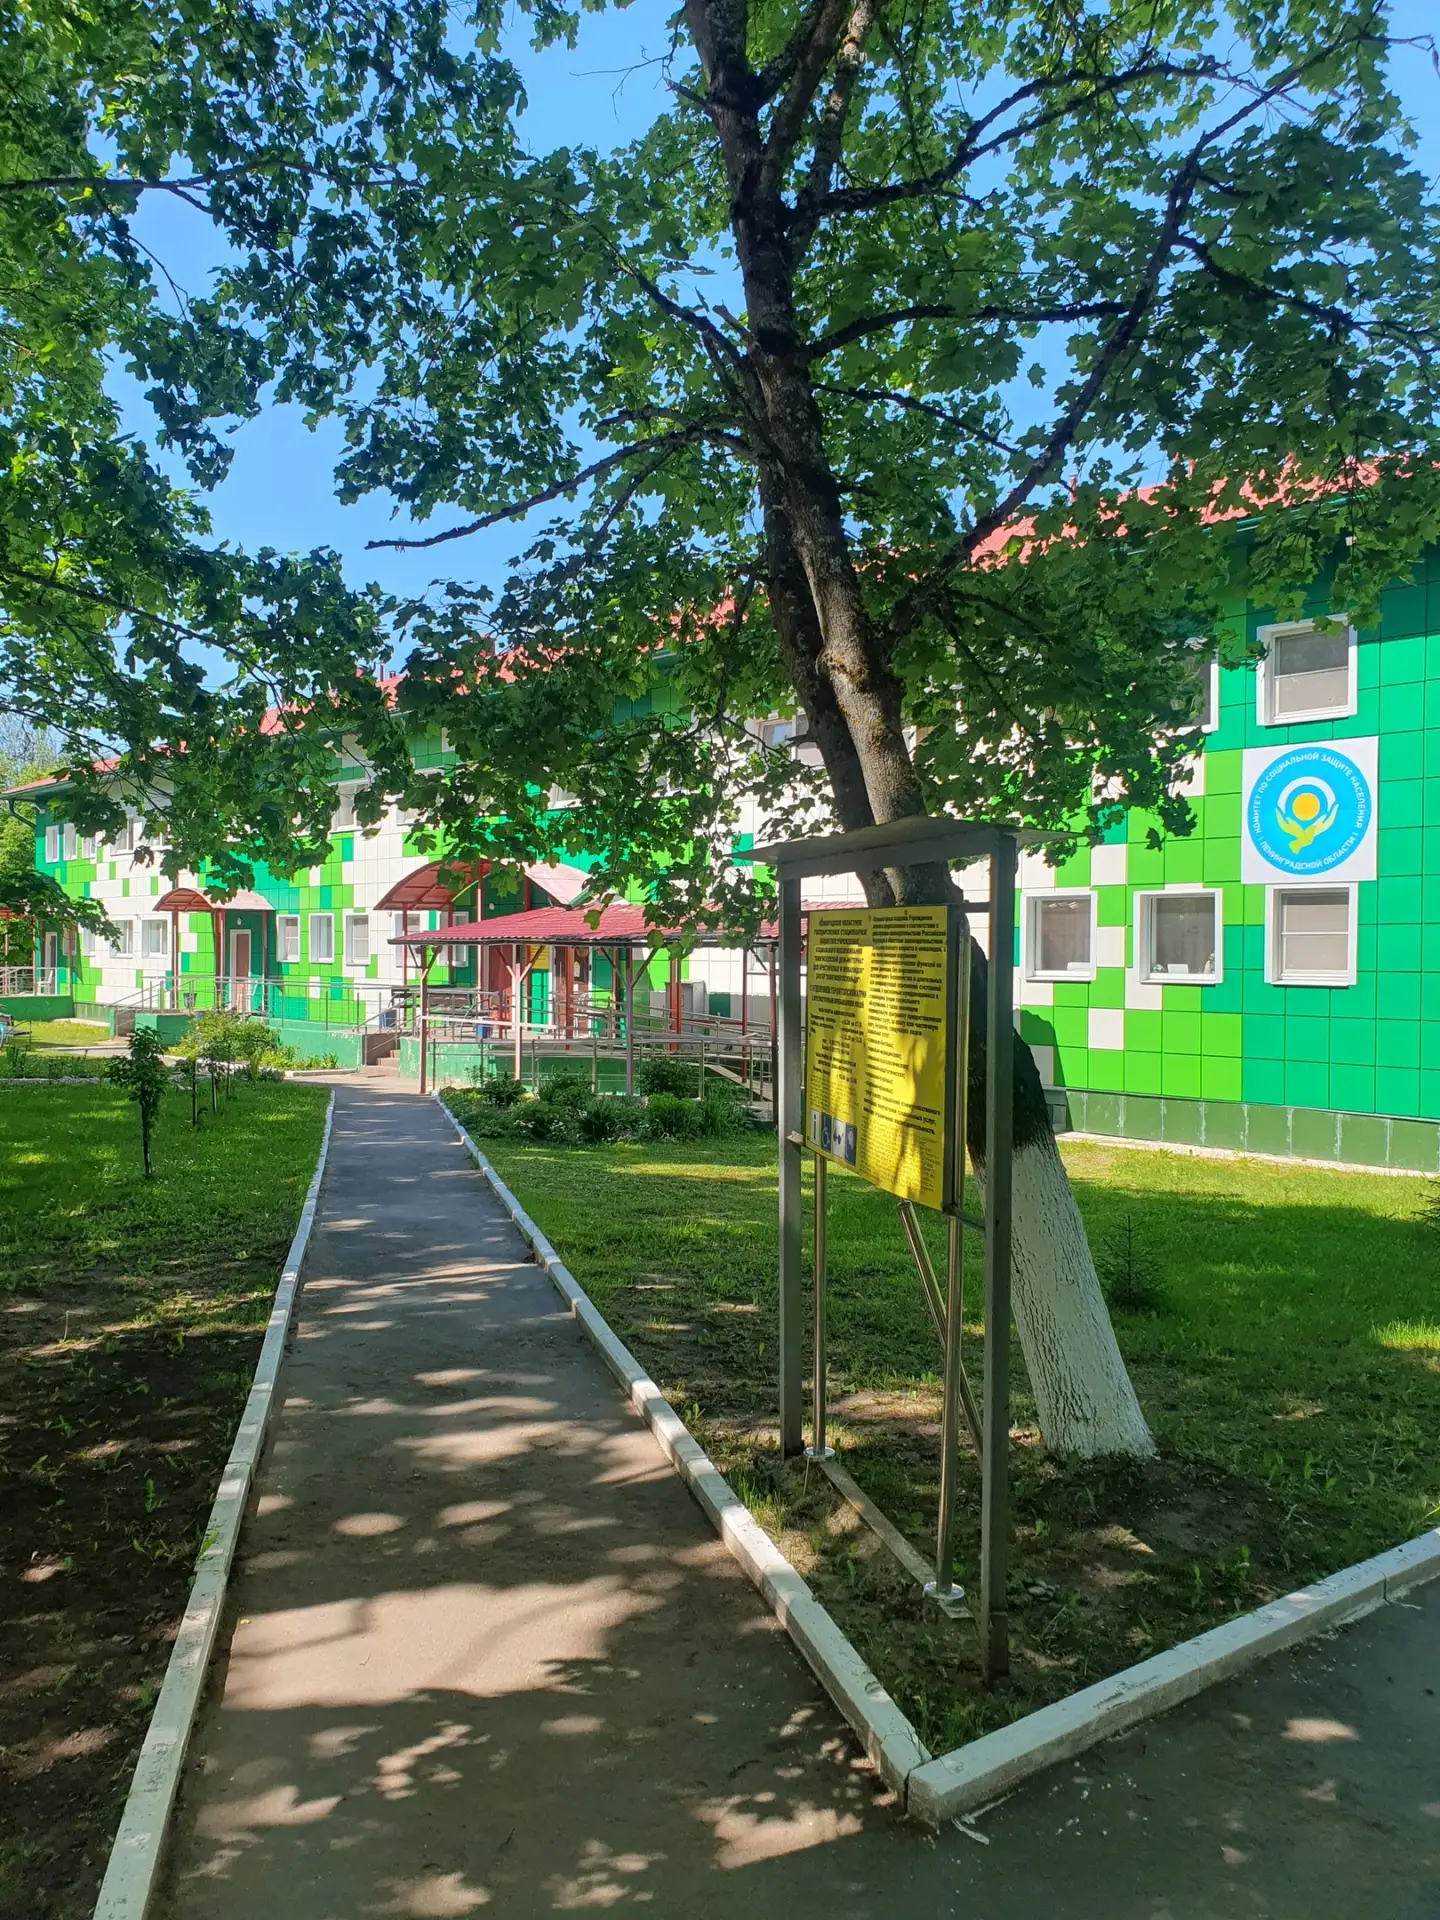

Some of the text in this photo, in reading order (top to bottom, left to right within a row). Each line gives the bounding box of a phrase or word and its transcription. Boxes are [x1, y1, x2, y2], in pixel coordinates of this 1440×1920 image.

[1252, 752, 1366, 833] КОМИТЕТ ПО СОЦИАЛЬНОЙ ЗАЩИТЕ НАСЕЛЕНИЯ
[1260, 837, 1356, 870] ЛЕНИНГРАДСКОЙ ОБЛАСТИ
